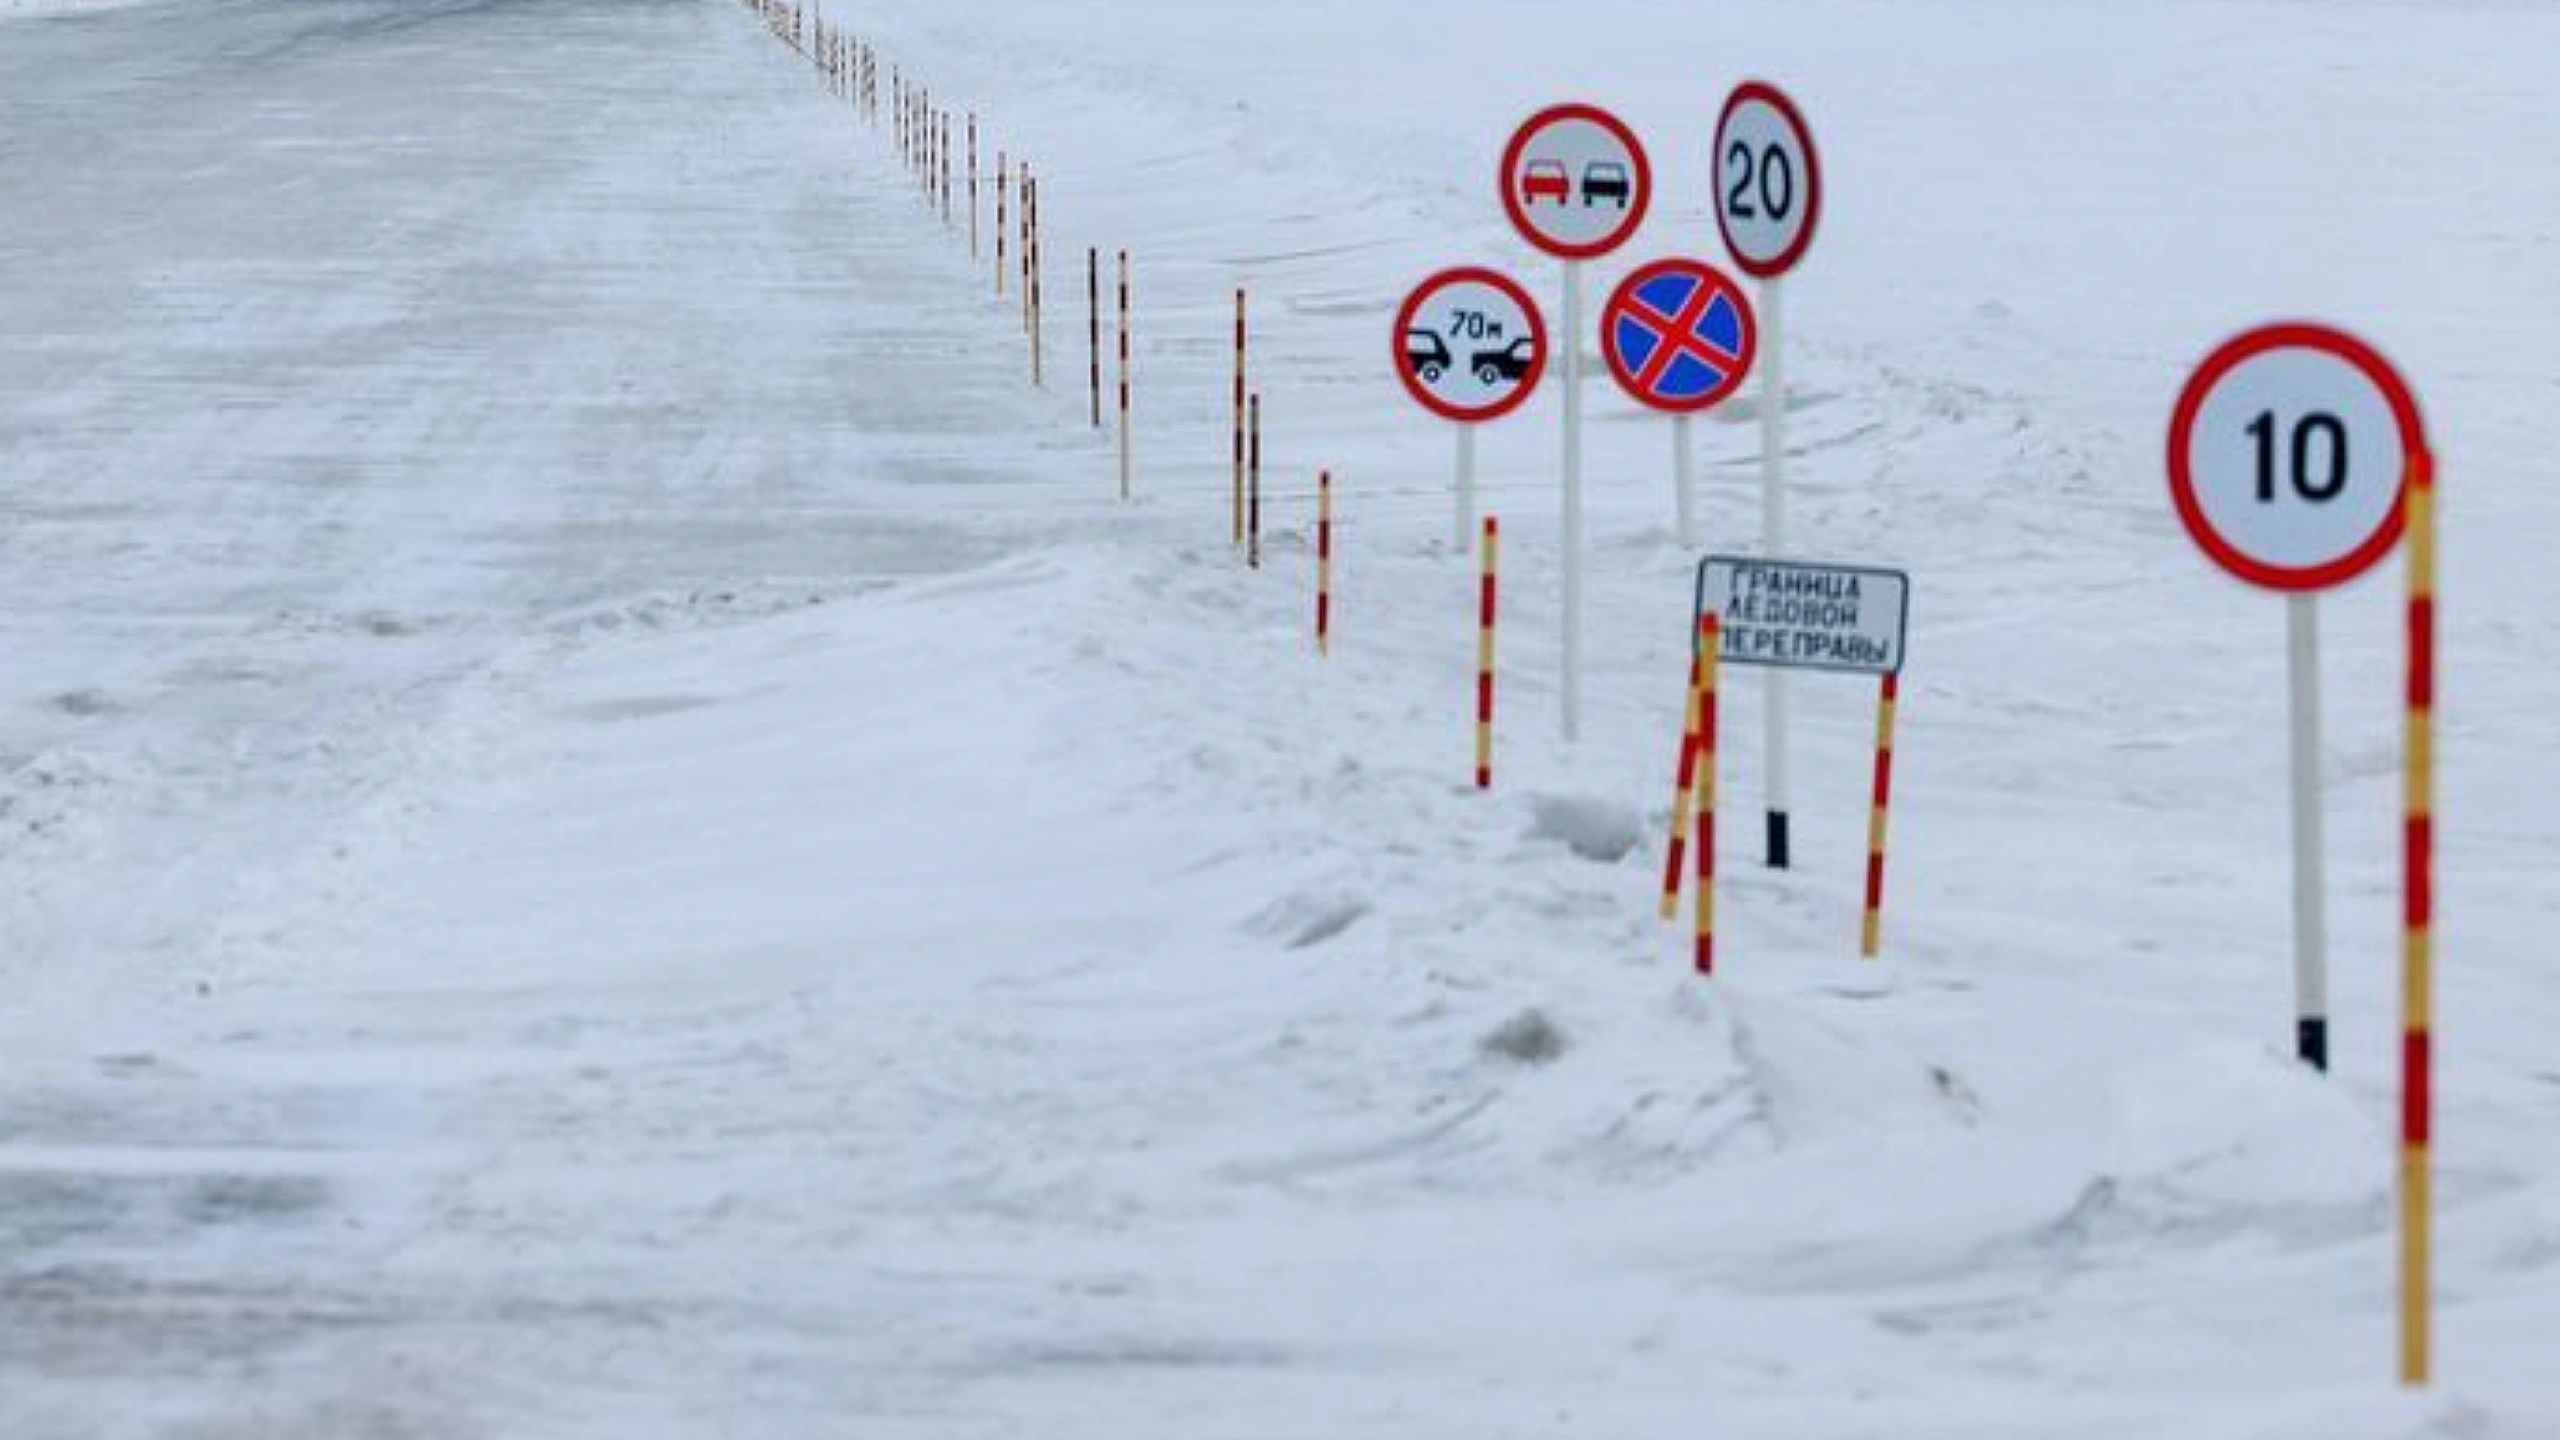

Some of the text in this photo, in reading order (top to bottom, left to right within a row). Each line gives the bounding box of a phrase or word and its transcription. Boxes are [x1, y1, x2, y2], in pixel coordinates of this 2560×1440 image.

[1728, 139, 1793, 221] 20
[2244, 409, 2348, 503] 10
[1730, 562, 1860, 599] ГРАНИЦА
[1726, 596, 1857, 629] ЛЕДОВОЙ
